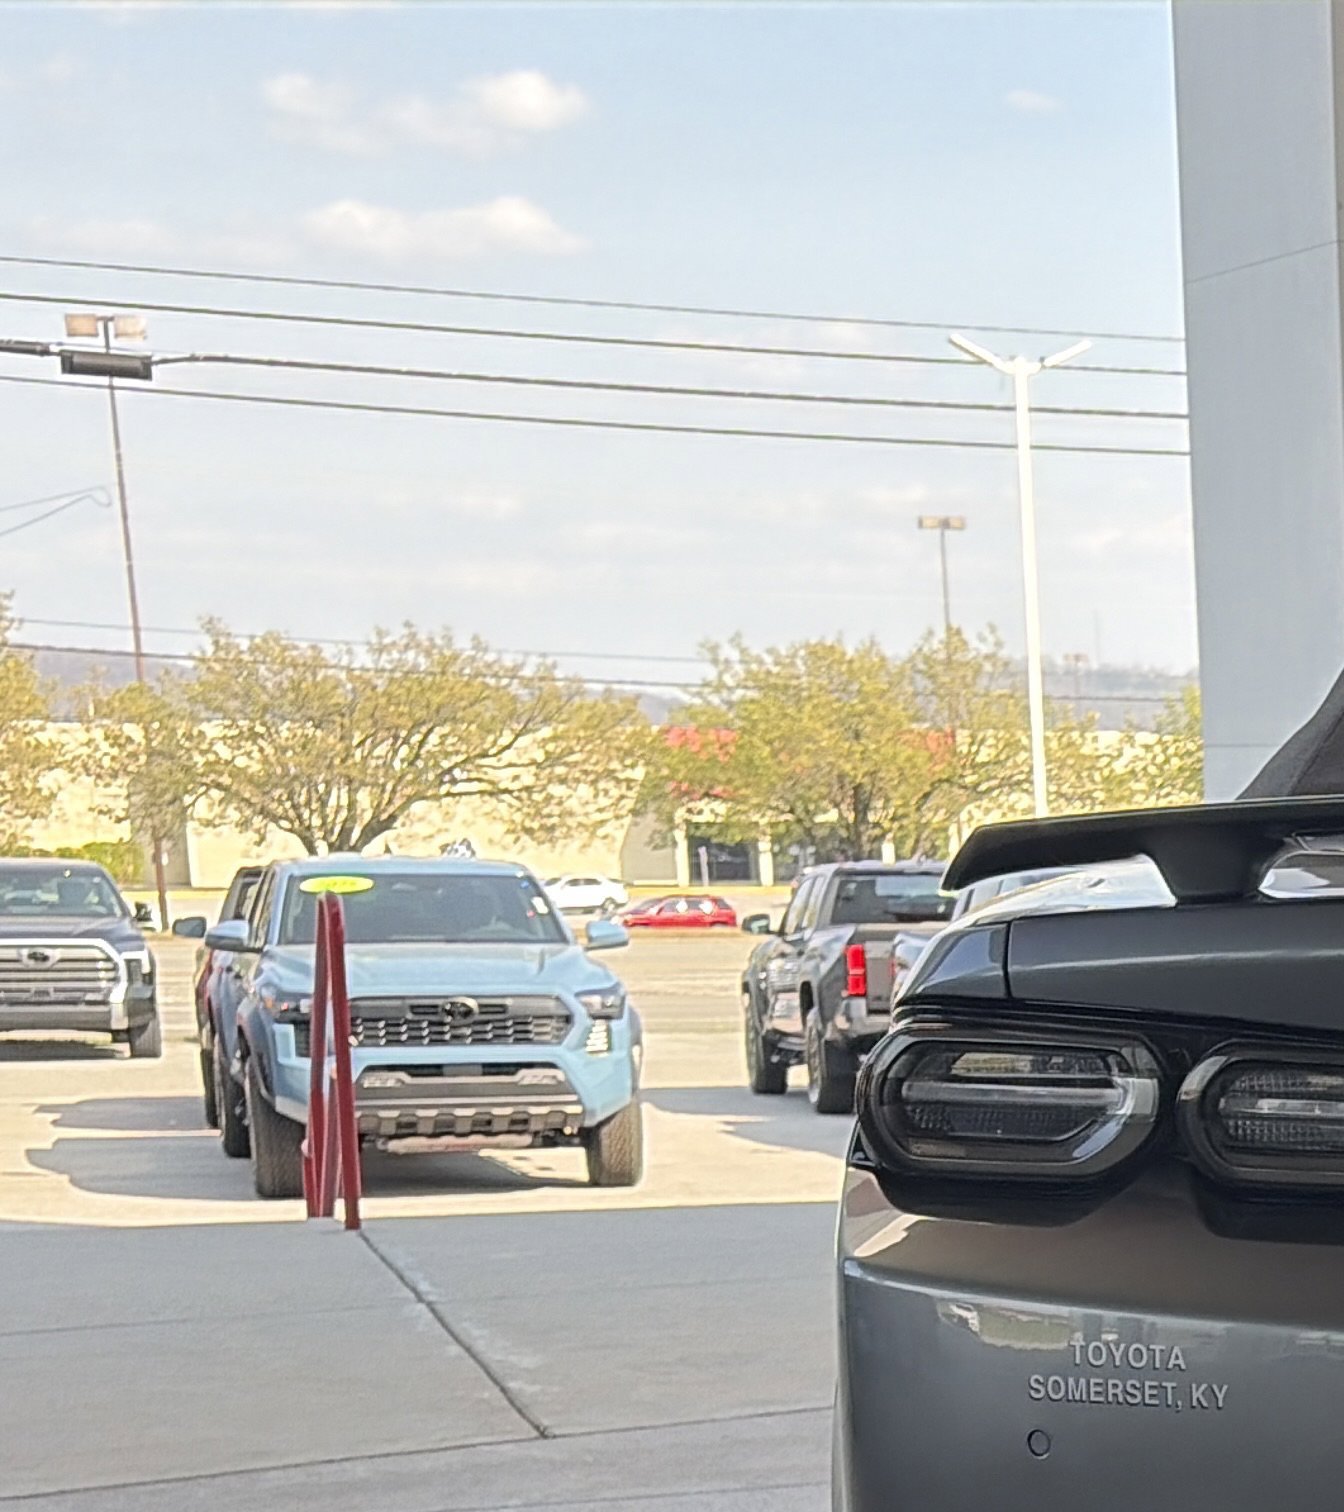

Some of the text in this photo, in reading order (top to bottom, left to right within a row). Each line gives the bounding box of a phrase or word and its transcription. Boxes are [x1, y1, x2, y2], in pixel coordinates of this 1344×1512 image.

[1070, 1341, 1187, 1370] TOYOTA
[1029, 1374, 1229, 1411] SOMERSET, KY
